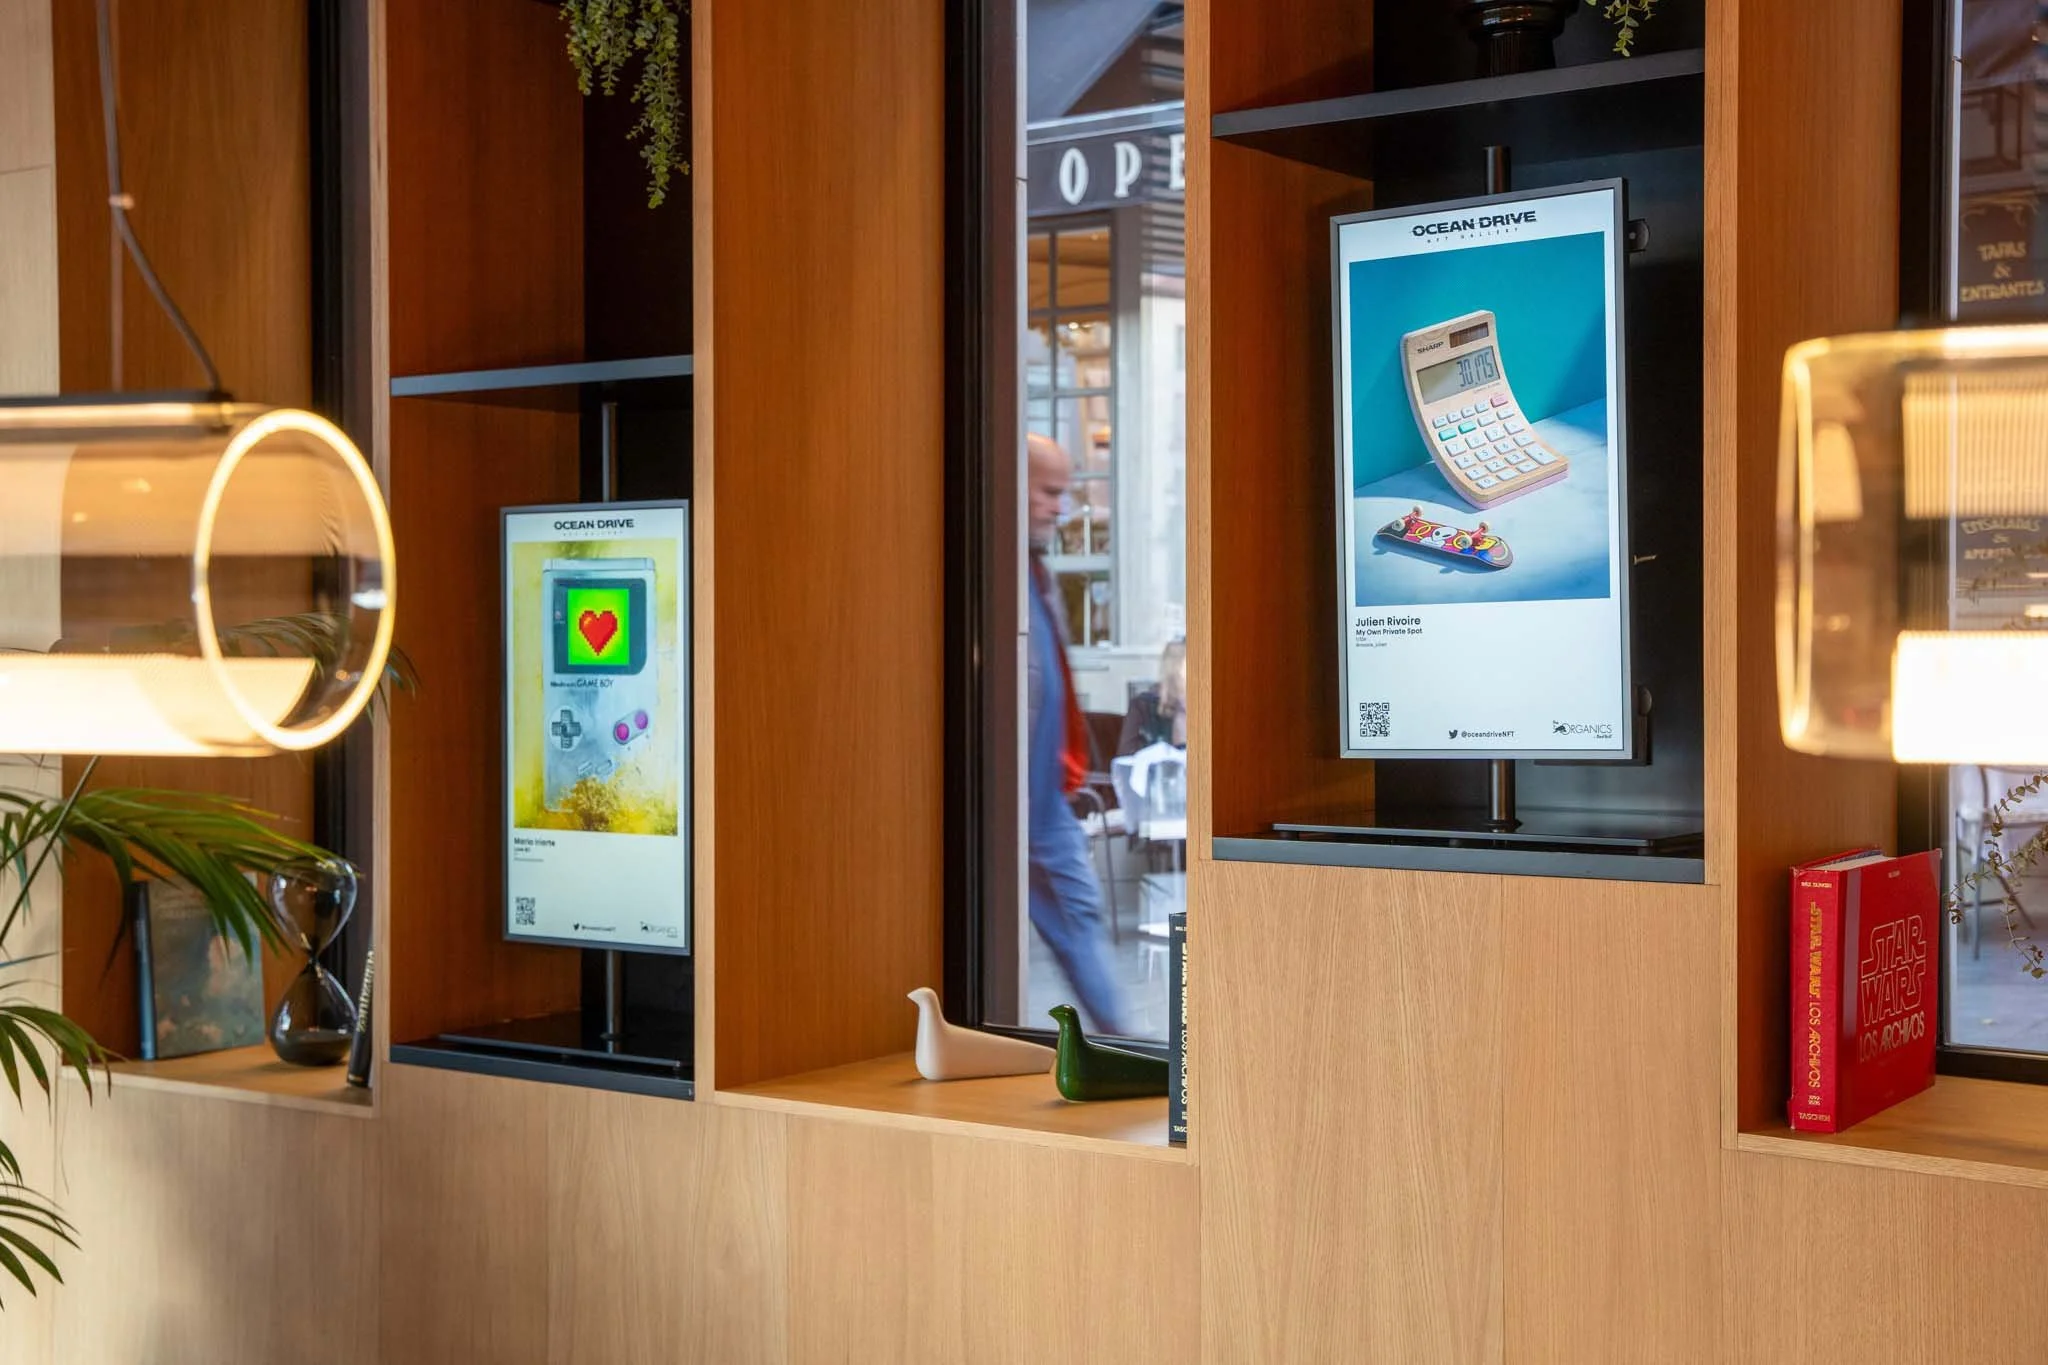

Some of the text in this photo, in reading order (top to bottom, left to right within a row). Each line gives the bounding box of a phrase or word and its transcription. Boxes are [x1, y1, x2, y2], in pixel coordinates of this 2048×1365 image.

[1412, 210, 1537, 237] OCEAN DRIVE
[554, 518, 634, 530] OCEAN DRIVE
[1355, 615, 1421, 627] Julien Rivoire
[1461, 730, 1515, 738] @oceandriveNFT
[1861, 915, 1927, 979] STAR
[1861, 960, 1927, 1027] WARS
[1808, 1002, 1821, 1025] LOS
[1859, 1010, 1926, 1064] LOS ARCHIVOS
[1808, 1027, 1821, 1088] ARCHIVOS
